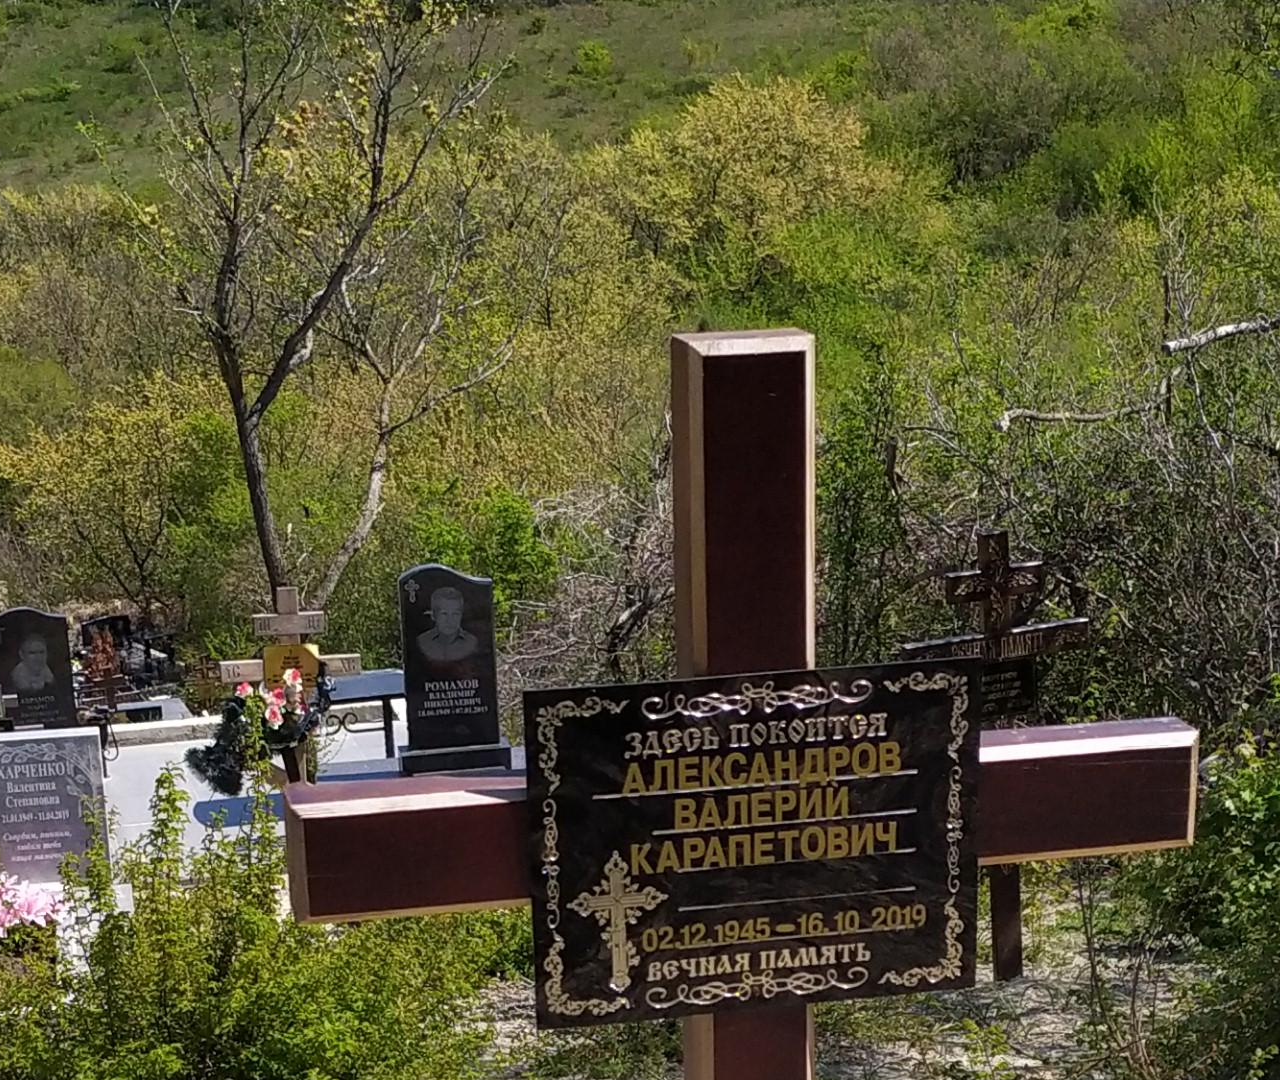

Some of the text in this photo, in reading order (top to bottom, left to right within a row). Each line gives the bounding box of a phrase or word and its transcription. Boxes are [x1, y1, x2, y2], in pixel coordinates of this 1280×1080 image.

[624, 712, 888, 760] ЗДЕСЬ ПОКОИТСЯ
[7, 782, 56, 793] Валентина
[622, 741, 902, 796] АЛЕКСАНДРОВ
[6, 796, 60, 808] Степановна
[674, 782, 849, 830] ВАЛЕРИЙ
[630, 821, 897, 876] КАРАПЕТОВИЧ
[646, 943, 871, 982] ВЕЧНАЯ ПАМЯТЬ
